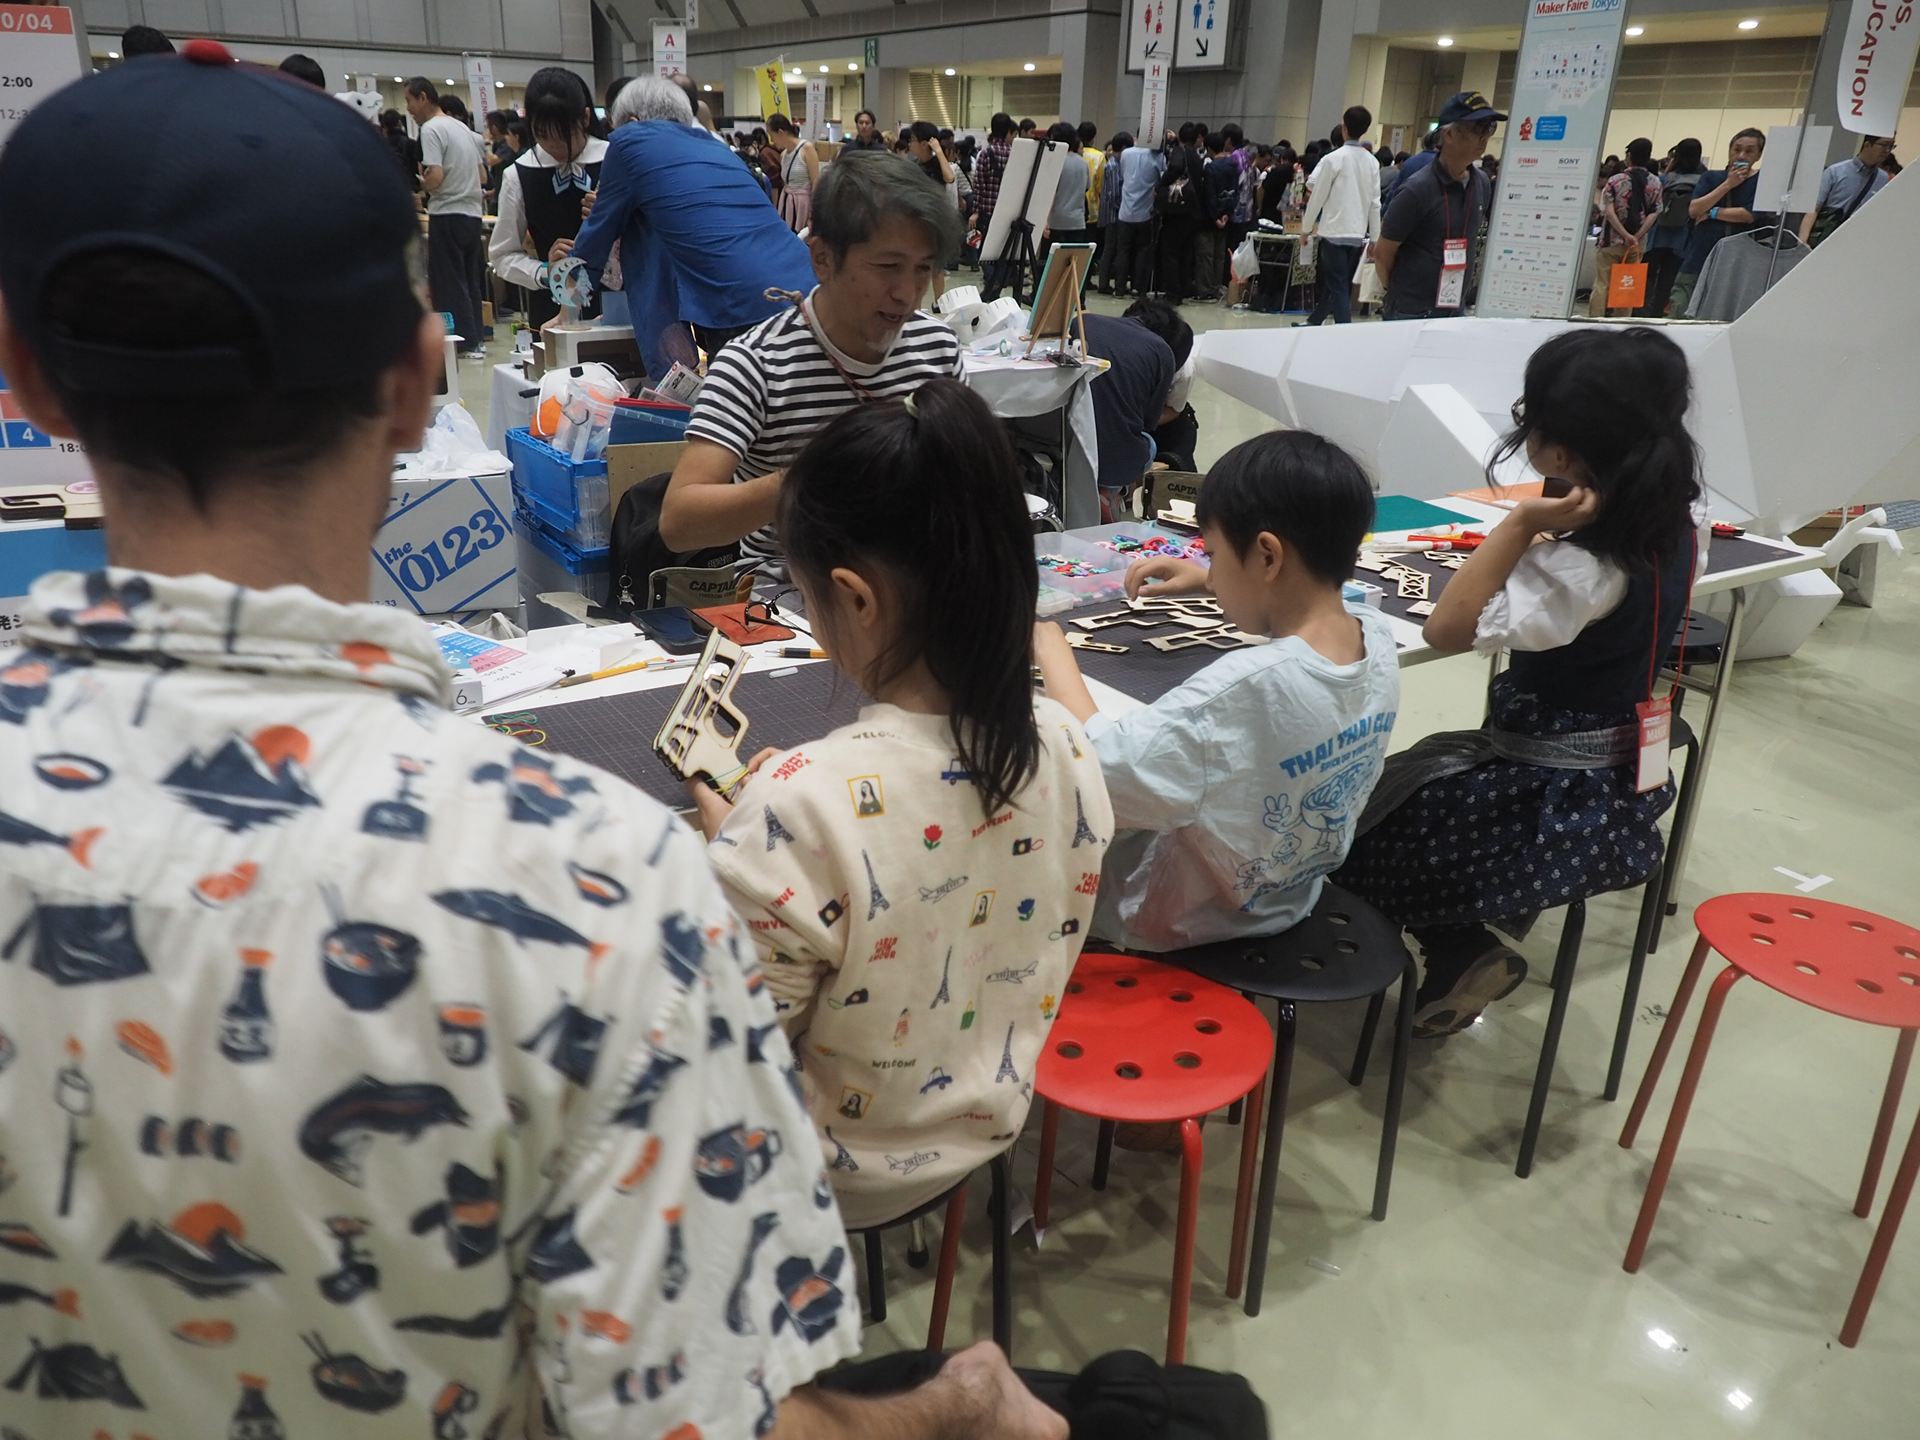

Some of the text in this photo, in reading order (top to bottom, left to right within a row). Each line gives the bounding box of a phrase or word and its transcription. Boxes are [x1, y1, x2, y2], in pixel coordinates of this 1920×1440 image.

[1536, 0, 1618, 15] Maker Faire Tokyo
[664, 33, 676, 48] A
[1152, 65, 1161, 77] H
[0, 108, 30, 120] 12:3
[1146, 93, 1157, 144] ELECTRONICS
[22, 427, 35, 442] 4
[1167, 483, 1200, 496] CAPTA
[383, 542, 413, 565] the
[399, 508, 506, 593] 0123
[456, 688, 467, 705] 6
[1280, 738, 1333, 779] THAI
[1337, 716, 1372, 750] THAI
[871, 1059, 917, 1069] WELCOME
